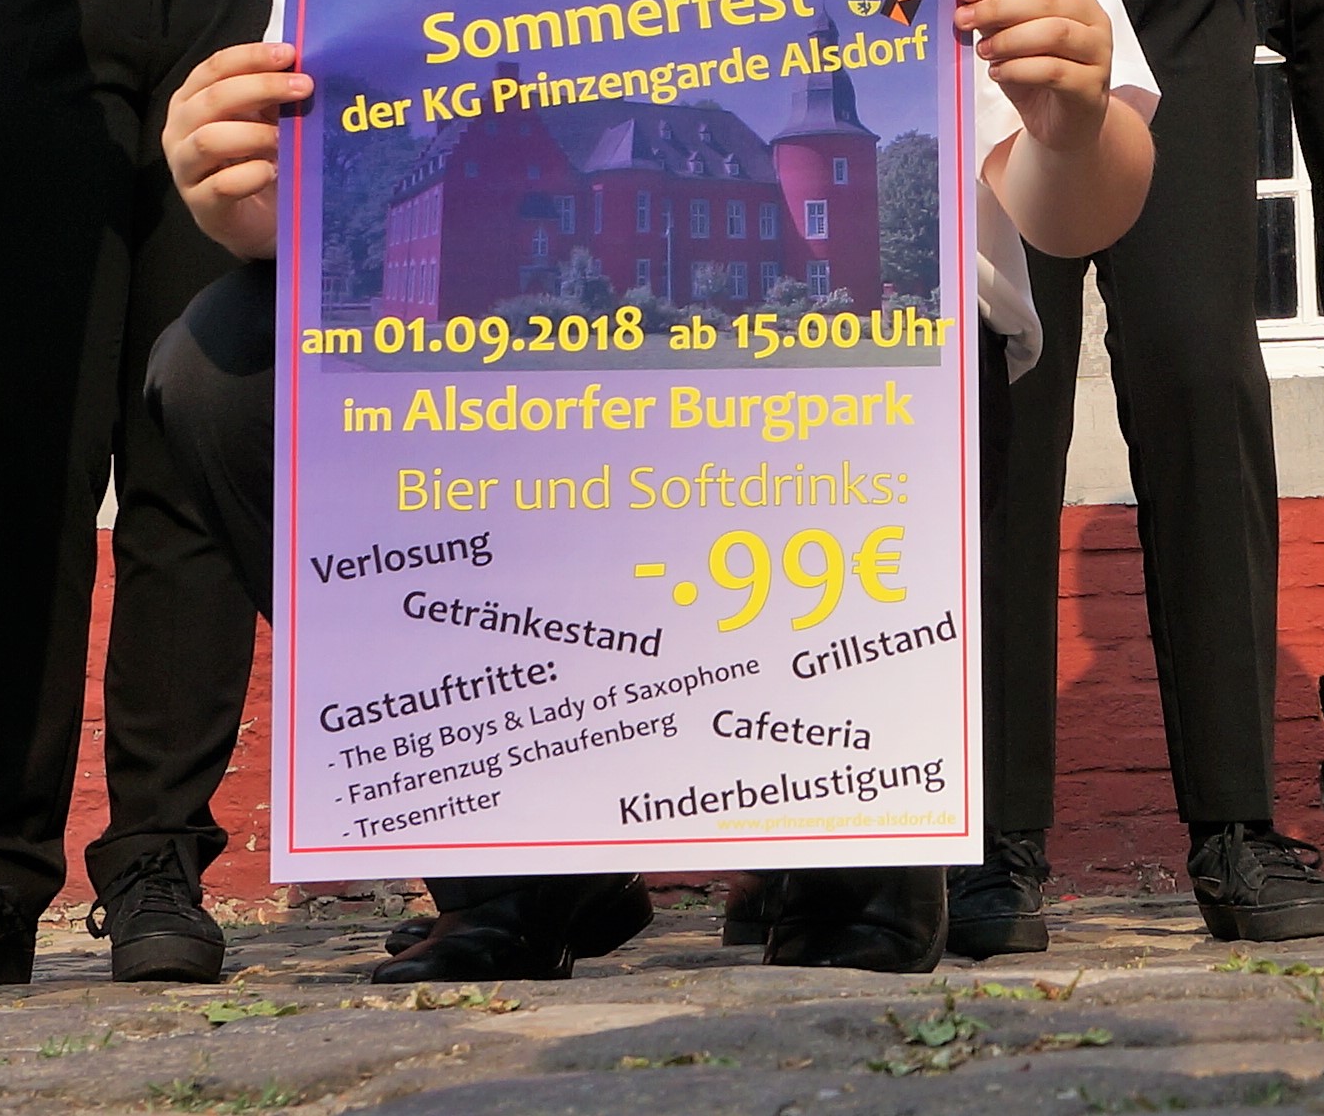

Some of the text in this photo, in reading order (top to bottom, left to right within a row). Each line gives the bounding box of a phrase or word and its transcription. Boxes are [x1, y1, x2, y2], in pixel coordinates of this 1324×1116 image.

[342, 24, 928, 132] der KG Prinzengarde Alsdorf
[301, 305, 956, 364] am 01.09.2018 ab 15.00 Uhr
[344, 380, 915, 443] im Alsdorfer Burgpark
[398, 460, 909, 511] Bier und Softdrinks:
[310, 532, 492, 583] Verlosung
[633, 525, 909, 633] -.99€
[403, 591, 662, 657] Getränkestand
[792, 611, 956, 679] Grillstand
[320, 662, 557, 732] Gastauftritte:
[340, 745, 387, 768] The
[393, 733, 434, 758] Big
[439, 720, 497, 746] Boys
[505, 711, 524, 731] &
[529, 697, 584, 725] Lady
[593, 686, 617, 710] of
[625, 660, 759, 704] Saxophone
[349, 753, 502, 804] Fanfarenzug
[508, 713, 677, 767] Schaufenberg
[713, 710, 870, 750] Cafeteria
[354, 791, 500, 838] Tresenritter
[620, 759, 945, 824] Kinderbelustigung
[717, 810, 957, 831] www.prinzengarde-alsdorf.de
